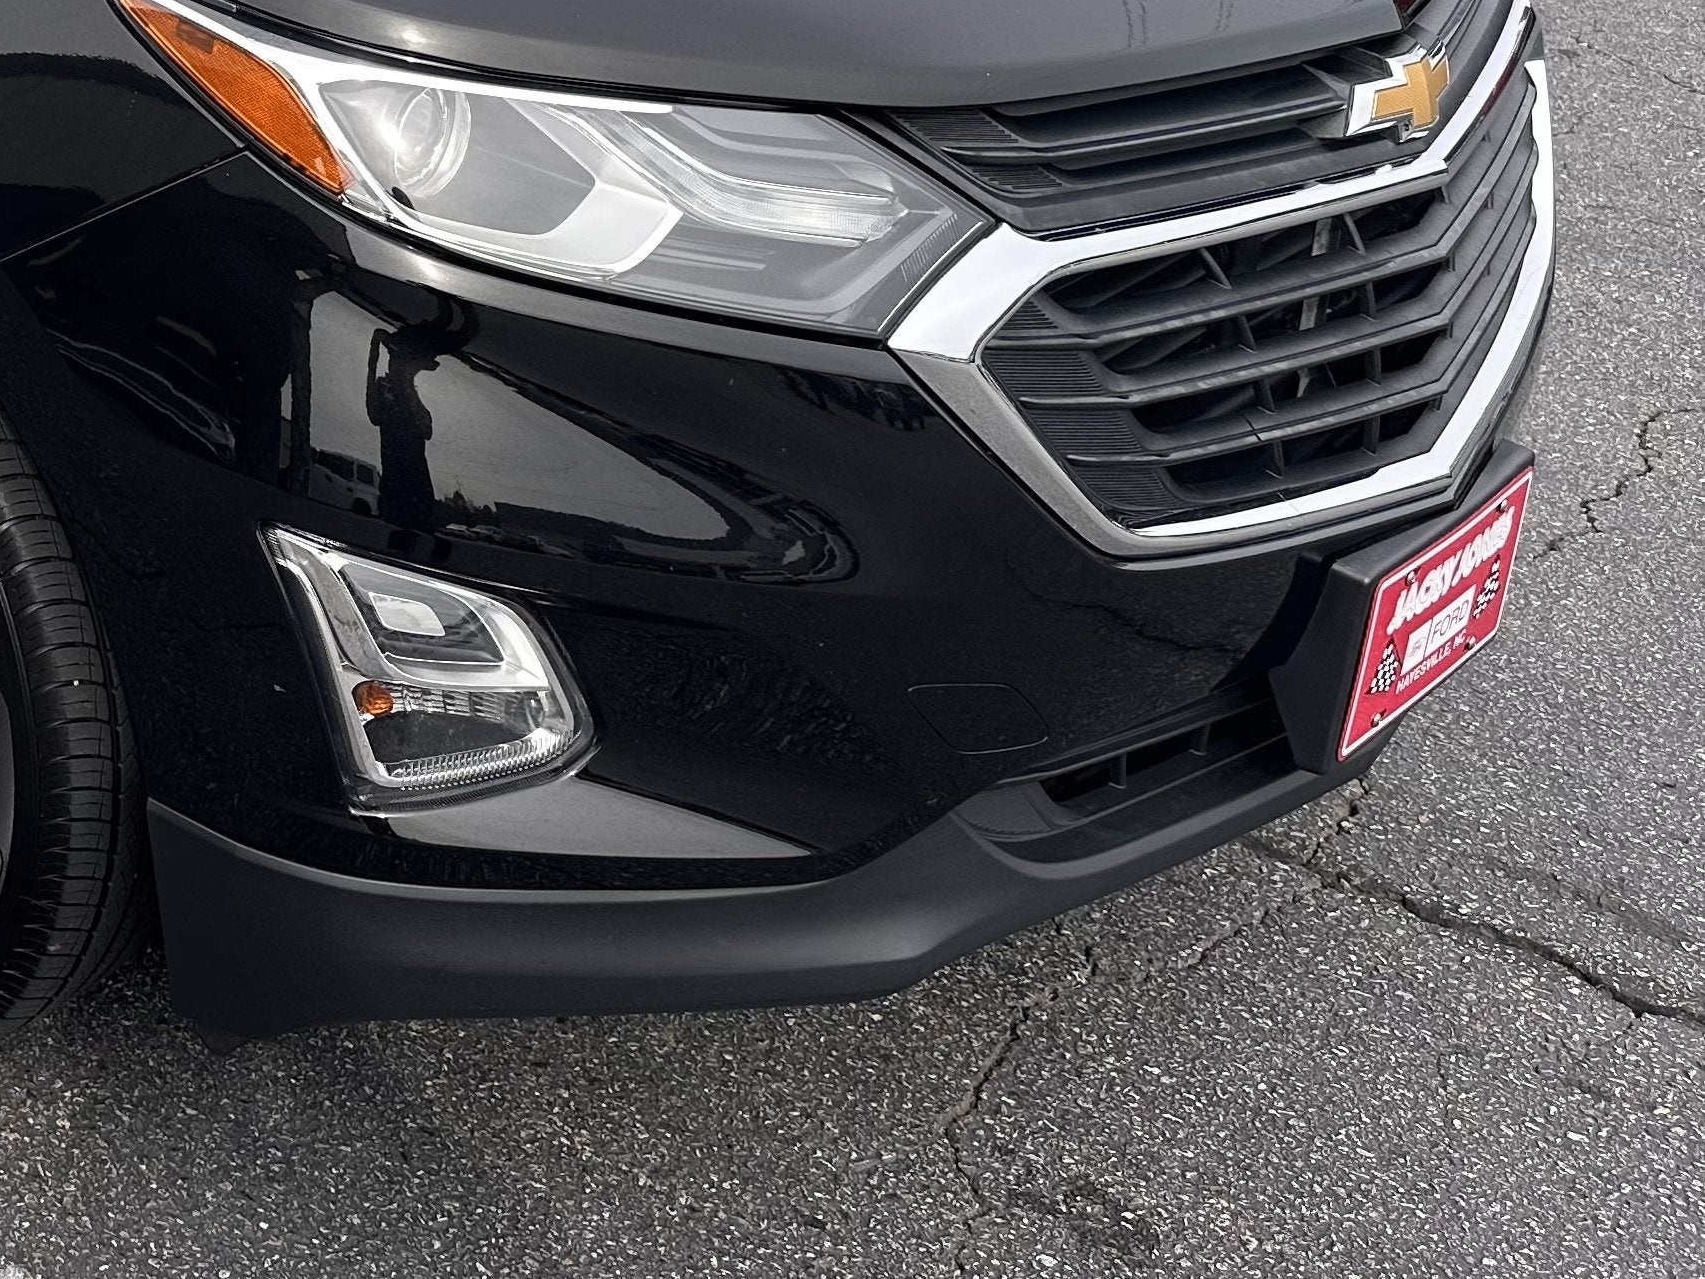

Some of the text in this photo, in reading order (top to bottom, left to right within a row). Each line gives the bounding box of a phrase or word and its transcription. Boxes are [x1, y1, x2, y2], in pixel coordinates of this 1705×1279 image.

[1386, 505, 1516, 636] JACKY JONES
[1430, 599, 1470, 644] FORD
[1452, 628, 1467, 650] NC
